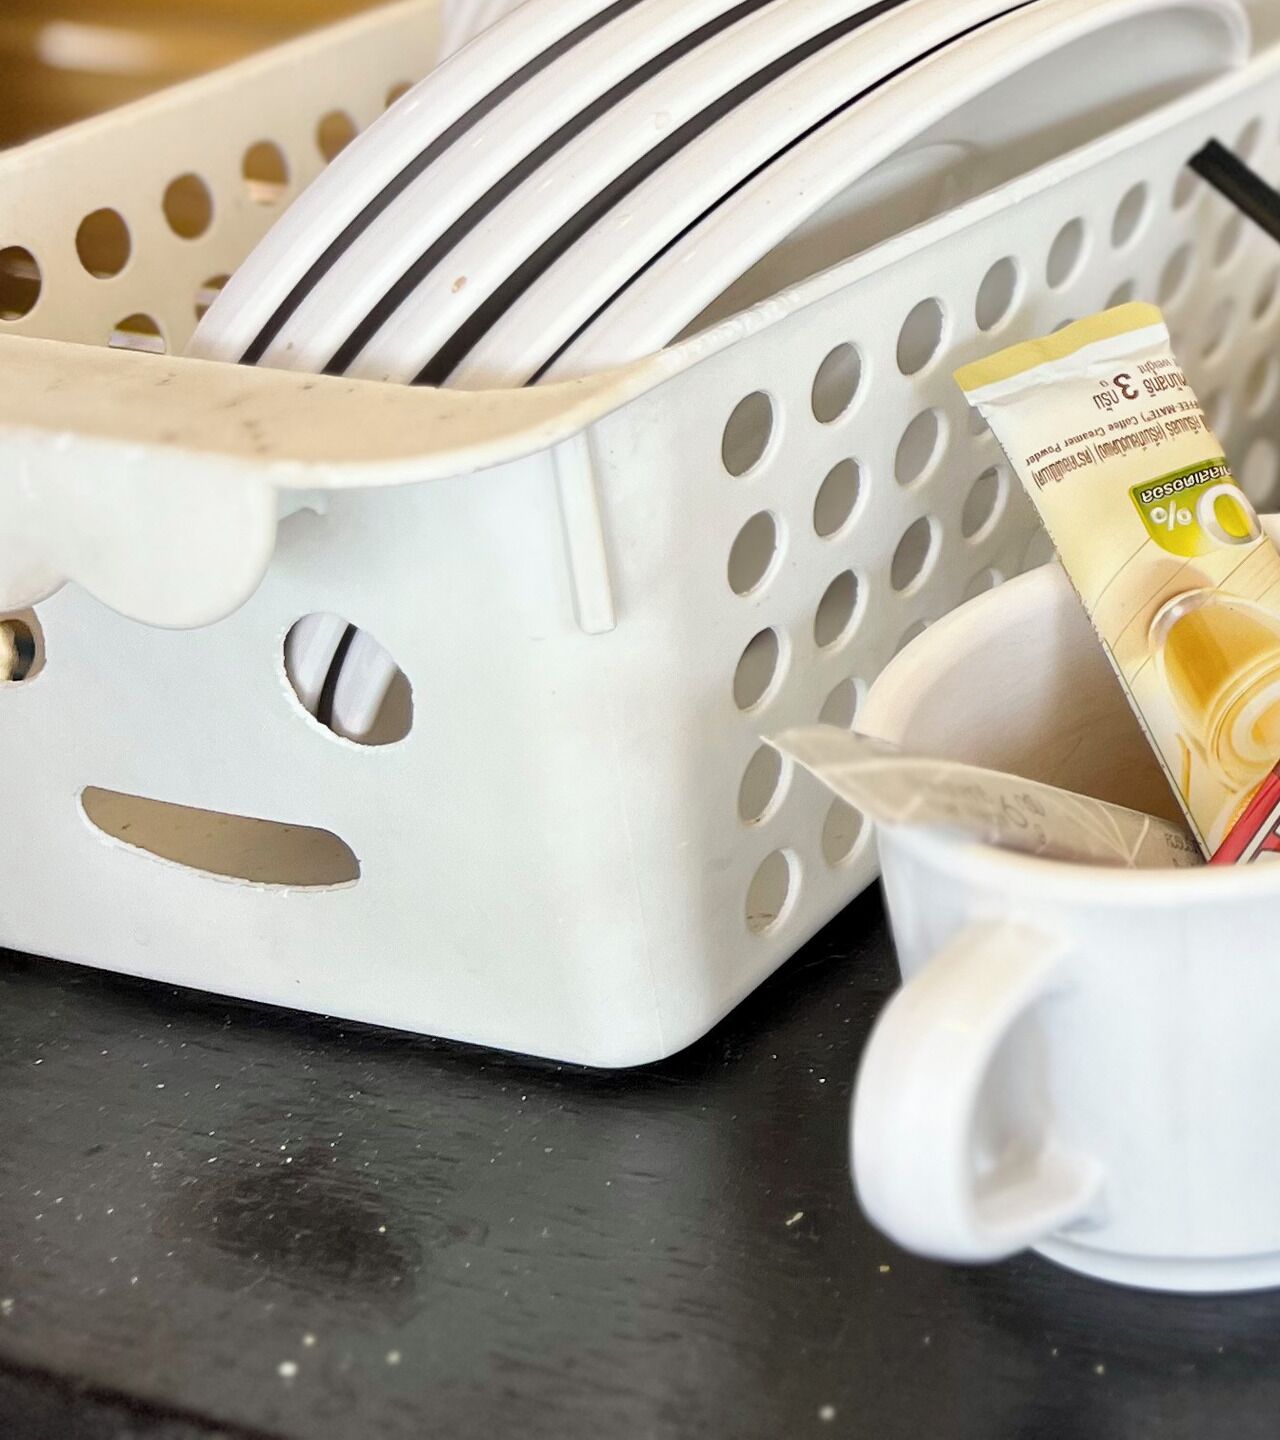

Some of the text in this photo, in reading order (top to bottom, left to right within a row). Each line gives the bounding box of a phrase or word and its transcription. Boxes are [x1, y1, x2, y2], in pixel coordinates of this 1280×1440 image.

[1112, 370, 1138, 399] 3
[1092, 388, 1117, 409] กรัม
[1107, 414, 1137, 432] Coffee
[1063, 424, 1106, 449] Creamer
[1023, 441, 1060, 467] Powder
